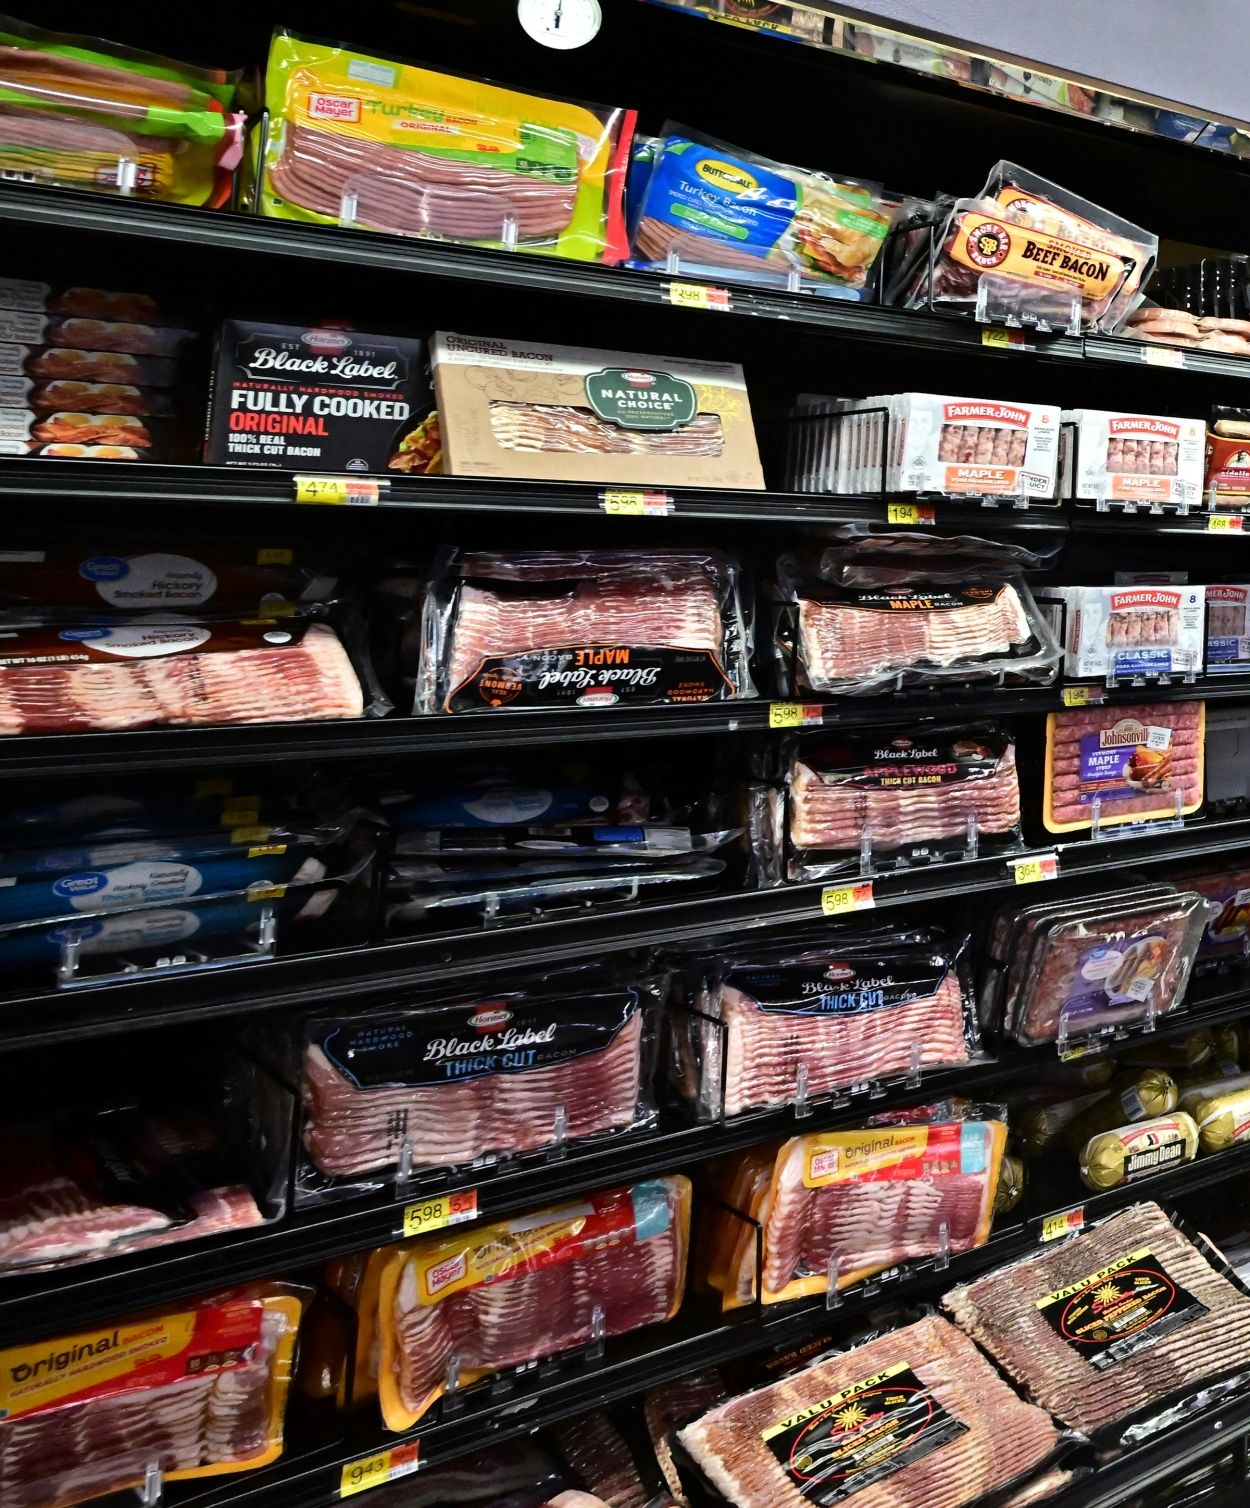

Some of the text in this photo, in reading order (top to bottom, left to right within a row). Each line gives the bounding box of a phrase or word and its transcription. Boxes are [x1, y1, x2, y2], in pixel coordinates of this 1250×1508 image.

[317, 97, 354, 109] Oscar
[315, 105, 354, 118] Mayer
[679, 180, 721, 203] Turkey
[1022, 240, 1060, 265] BEEF
[1062, 257, 1110, 281] BACON
[511, 349, 553, 362] BACON
[249, 348, 396, 379] Black Label
[601, 389, 683, 403] NATURAL
[231, 389, 410, 421] FULLY COOKED
[617, 400, 670, 410] CHOICE
[948, 405, 1027, 424] FARMER JOHN
[1041, 415, 1049, 424] 8
[229, 411, 329, 436] ORIGINAL
[1112, 419, 1178, 435] FARMER JOHN
[228, 433, 286, 445] 100% REAL
[228, 443, 321, 457] THICK CUT BACON
[957, 468, 1004, 480] MAPLE
[305, 481, 339, 497] 474
[1122, 479, 1161, 488] MAPLE
[892, 507, 913, 519] 194
[152, 580, 202, 590] Hickory
[114, 590, 202, 599] Smoked Bacon
[1114, 592, 1178, 607] FARMER JOHN
[1189, 594, 1197, 604] 8
[1223, 589, 1245, 600] JOHN
[889, 600, 934, 609] MAPLE
[575, 649, 629, 665] MAPLE
[1118, 650, 1169, 659] CLASSIC
[478, 679, 523, 691] VERMONT
[538, 667, 662, 690] Black Label
[774, 707, 798, 724] 598
[1102, 729, 1150, 747] Johnsonvill
[874, 749, 938, 759] Black Label
[1088, 755, 1120, 766] MAPLE
[1018, 864, 1037, 879] 364
[60, 877, 98, 889] Great
[826, 893, 848, 911] 598
[849, 975, 896, 990] Label
[820, 993, 856, 1011] THICK
[475, 1013, 508, 1025] Hormel
[423, 1023, 557, 1062] Black Label
[445, 1056, 497, 1077] THICK
[502, 1049, 537, 1068] CUT
[845, 1135, 895, 1160] Original
[1128, 1143, 1182, 1172] Jimmy Dean
[409, 1204, 443, 1231] 598
[1046, 1219, 1064, 1236] 414
[1051, 1256, 1138, 1301] VALU PACK
[10, 1325, 164, 1383] Original BACON
[781, 1400, 833, 1428] VALU
[840, 1371, 890, 1399] PACK
[350, 1457, 384, 1485] 943
